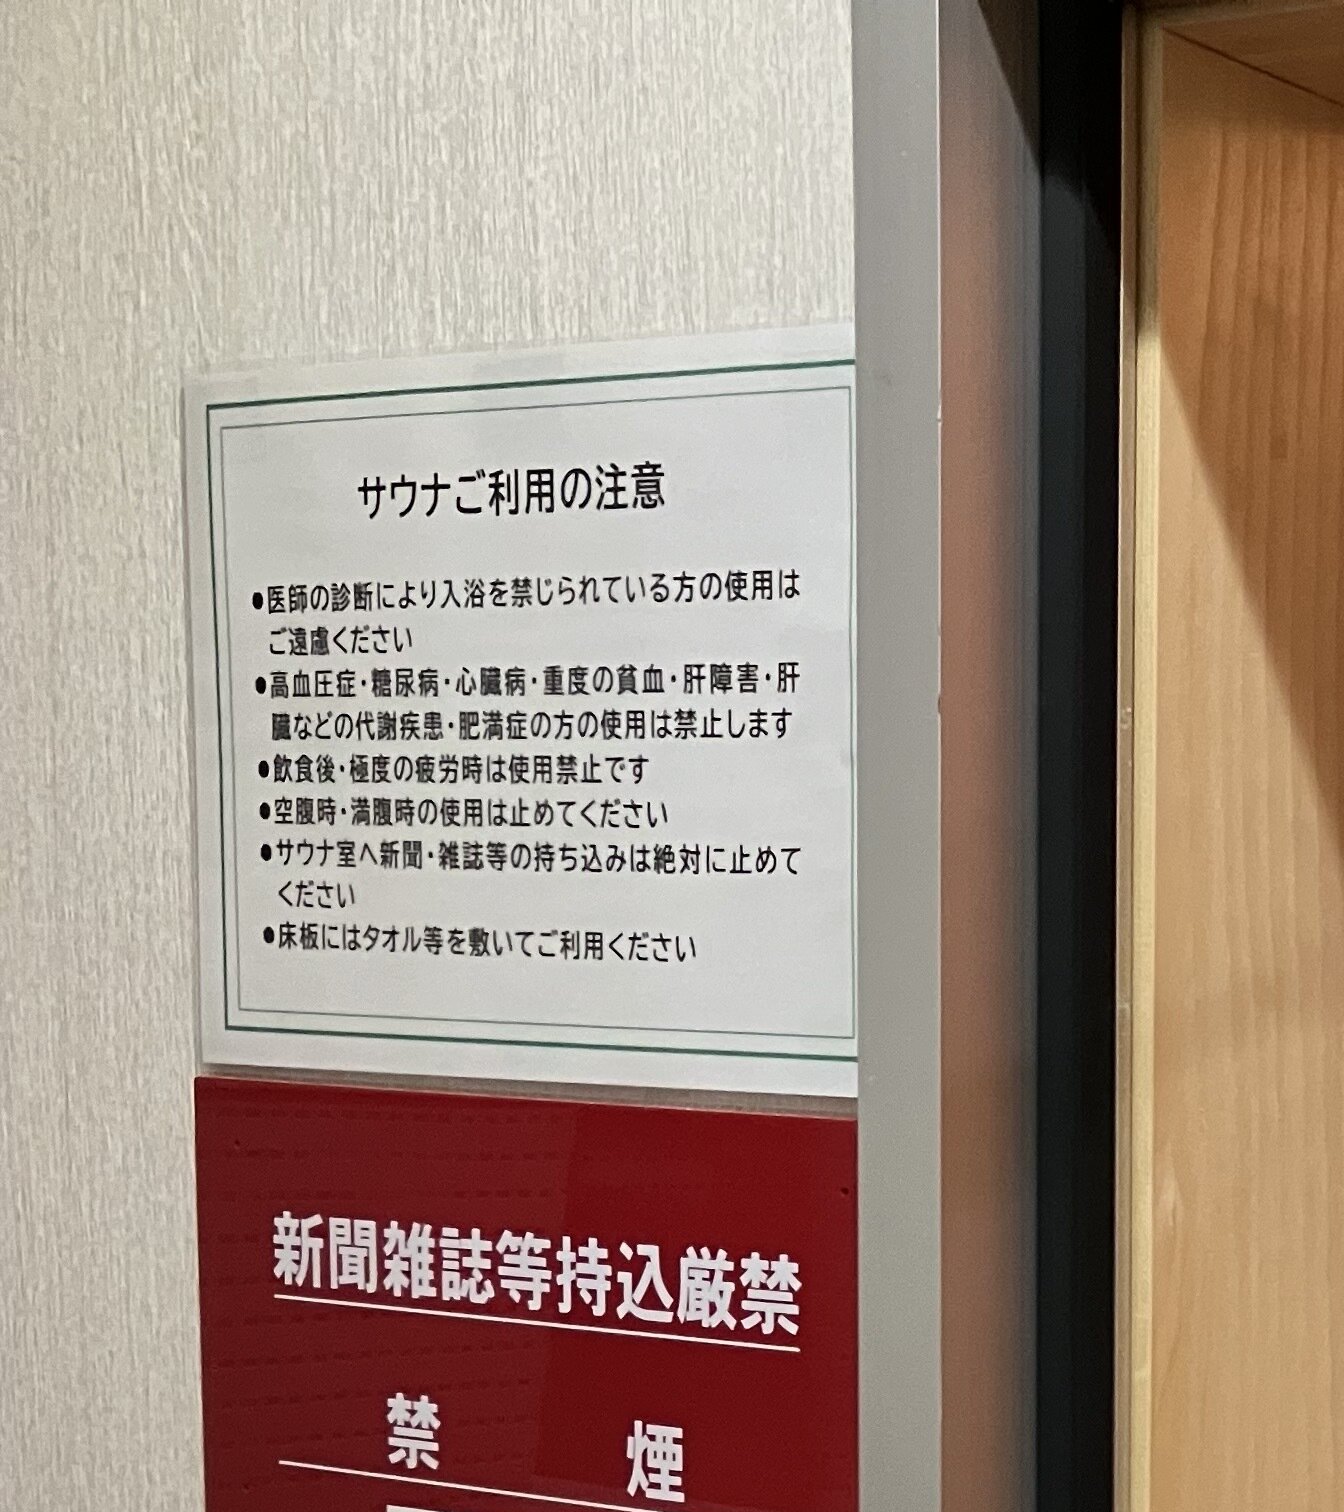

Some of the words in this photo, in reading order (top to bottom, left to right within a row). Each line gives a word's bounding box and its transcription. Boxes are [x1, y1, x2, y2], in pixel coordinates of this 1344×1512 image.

[357, 460, 666, 520] サウナご利用の注意
[269, 625, 413, 656] ご遠慮ください
[278, 880, 356, 909] ください
[278, 920, 697, 962] 床板にはタオル等を敷いてご利用ください
[272, 1211, 803, 1336] 新聞雑誌等持込厳禁
